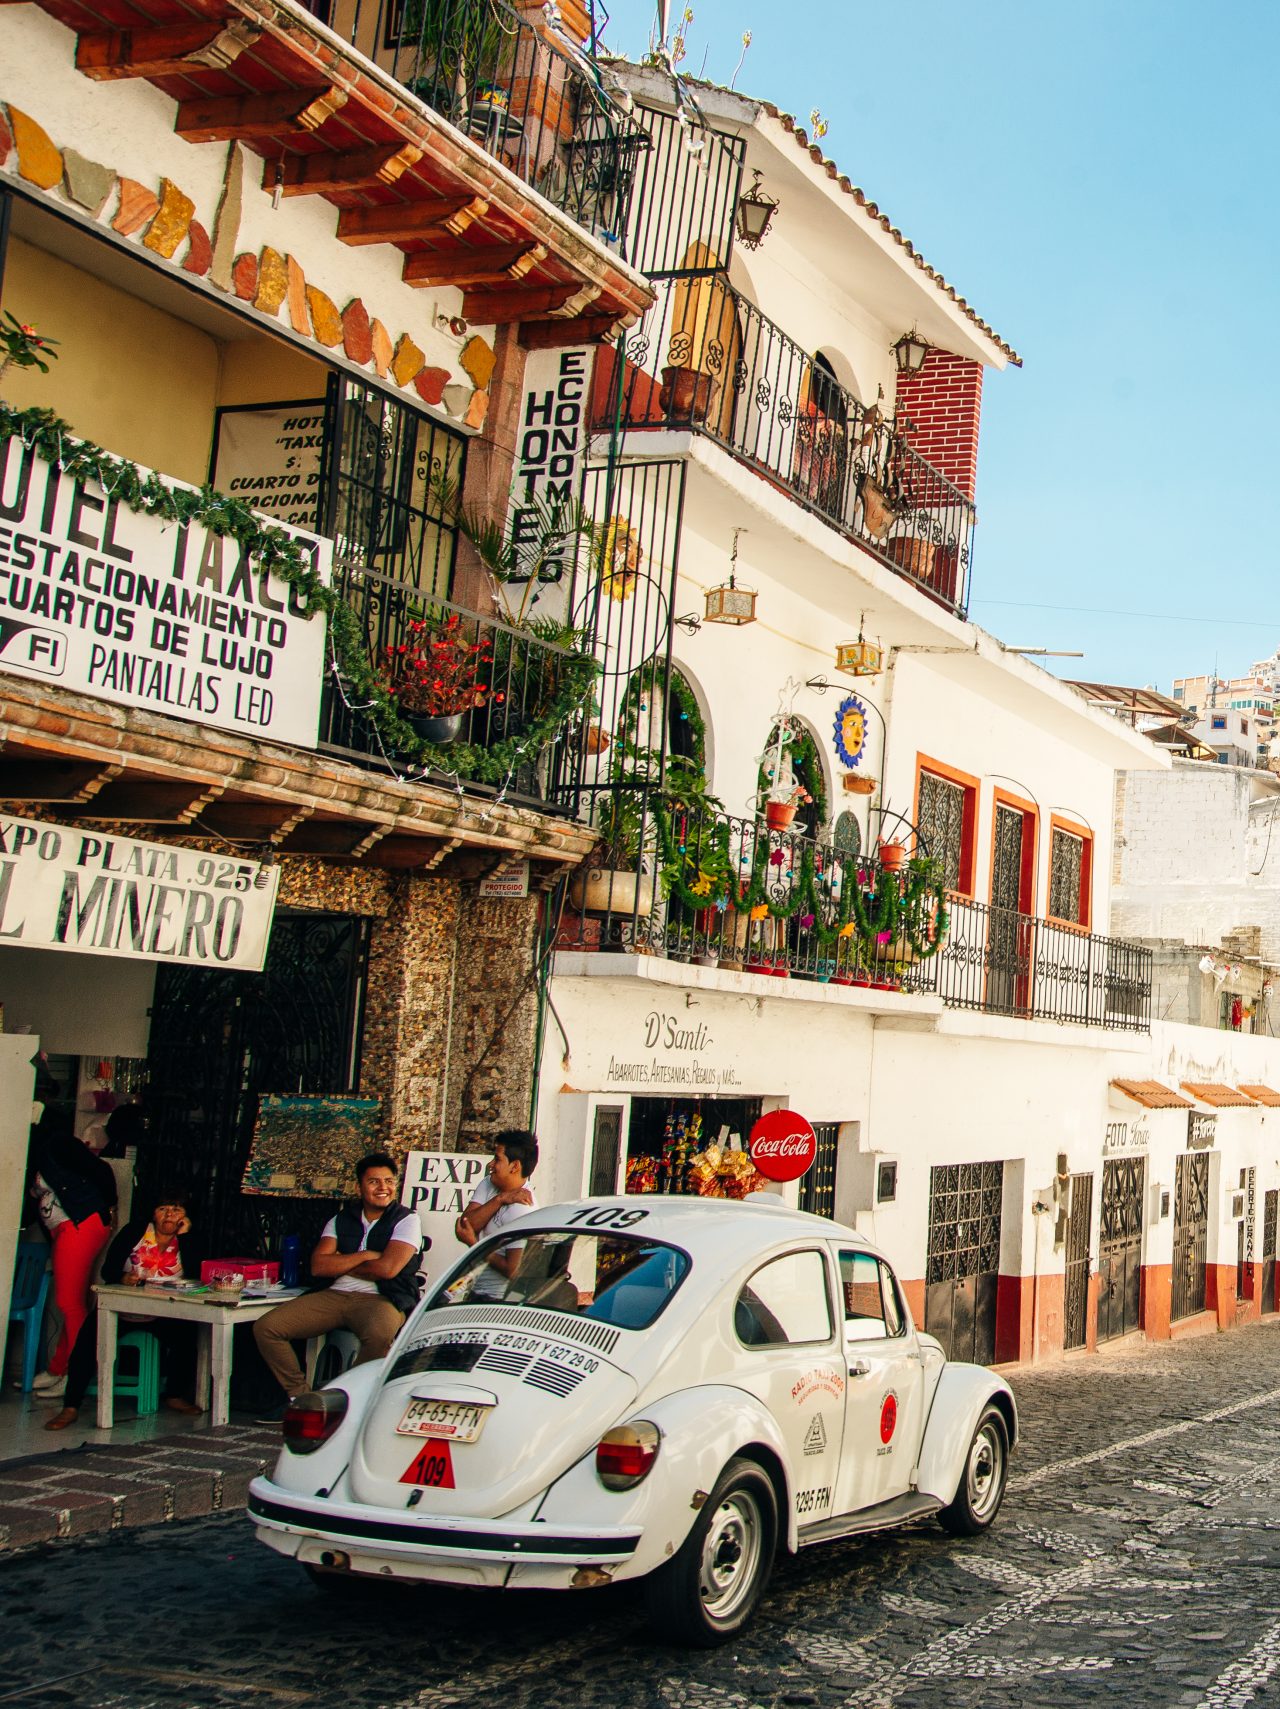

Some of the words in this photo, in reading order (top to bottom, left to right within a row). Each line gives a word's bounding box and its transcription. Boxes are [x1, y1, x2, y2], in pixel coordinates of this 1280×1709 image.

[283, 416, 324, 431] HOT
[230, 474, 301, 490] CUARTO
[507, 390, 554, 584] HOTEL
[150, 616, 190, 658] DE
[201, 631, 273, 681] LUJO
[87, 642, 221, 715] PANTALLAS
[234, 681, 274, 727] LED
[77, 836, 179, 882] PLATA
[51, 868, 244, 962] MINERO
[644, 1011, 714, 1051] D'Santi
[692, 1060, 716, 1085] REGALOS
[1105, 1122, 1128, 1147] FOTO
[418, 1157, 492, 1184] EXP
[565, 1206, 650, 1229] 109
[493, 1333, 515, 1346] 622
[511, 1337, 527, 1349] 03
[523, 1339, 540, 1352] 01
[541, 1343, 550, 1354] Y
[549, 1347, 569, 1360] 627
[568, 1352, 585, 1366] 29
[583, 1358, 600, 1373] 00
[407, 1402, 484, 1428] 64-65-FFN
[417, 1455, 446, 1486] 109
[814, 1486, 831, 1510] FFN
